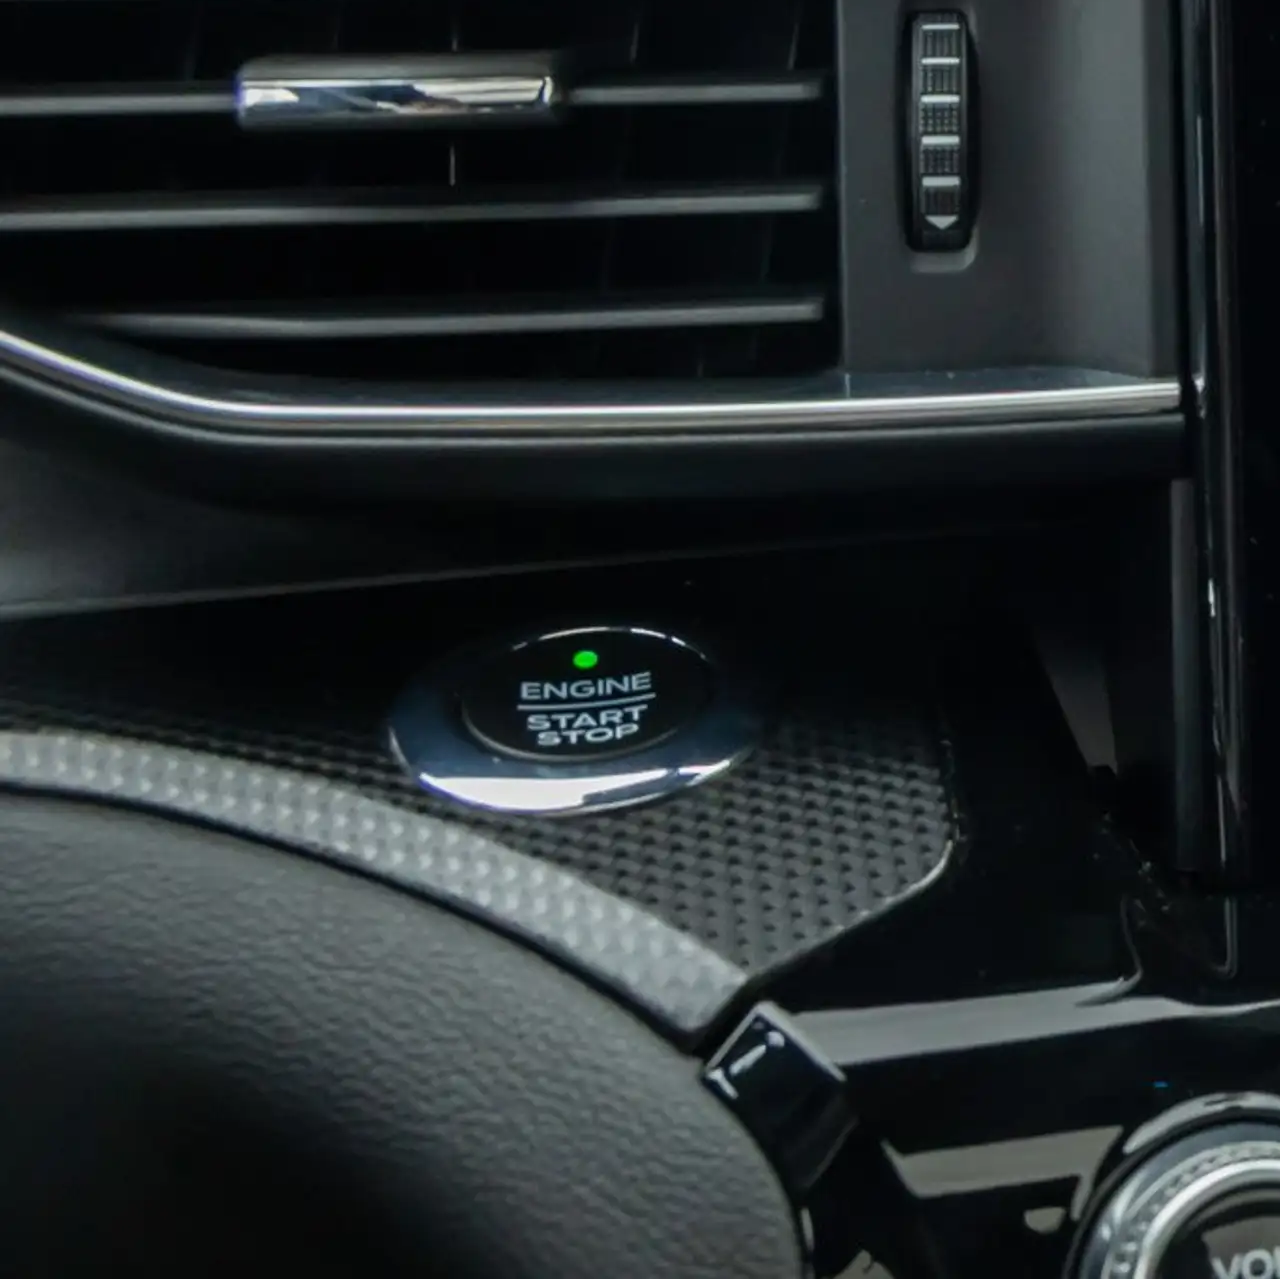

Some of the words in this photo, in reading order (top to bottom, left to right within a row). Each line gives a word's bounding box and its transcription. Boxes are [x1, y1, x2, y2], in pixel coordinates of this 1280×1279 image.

[520, 671, 652, 700] ENGINE
[527, 704, 648, 730] START
[537, 723, 640, 747] STOP
